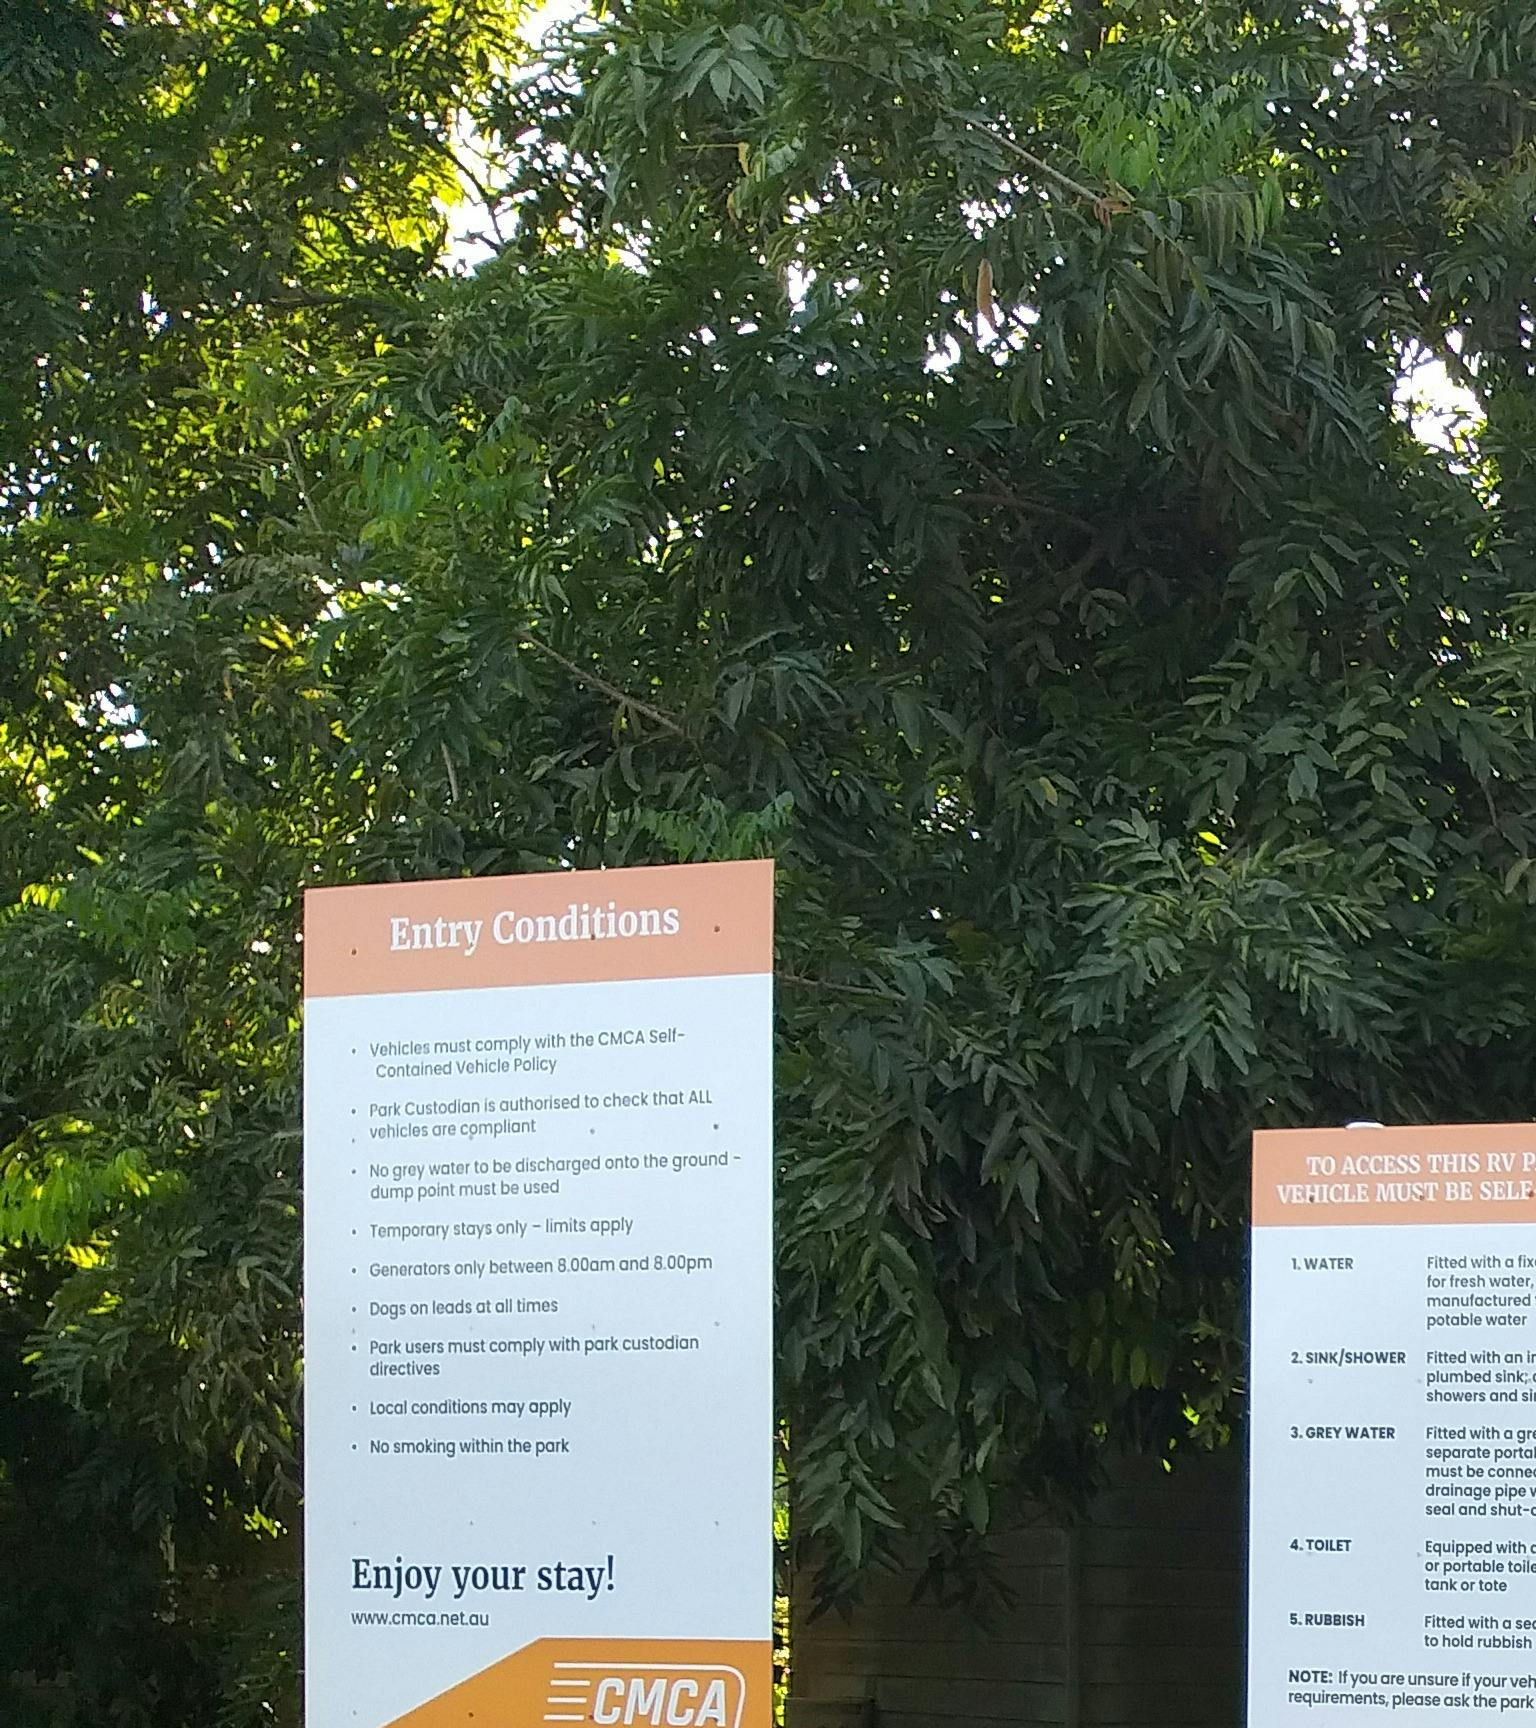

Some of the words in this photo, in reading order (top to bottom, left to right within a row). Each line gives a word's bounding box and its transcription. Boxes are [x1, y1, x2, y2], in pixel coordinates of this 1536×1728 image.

[390, 917, 483, 956] Entry
[493, 901, 679, 944] Conditions
[1306, 1156, 1335, 1175] TO
[1341, 1154, 1420, 1174] ACCESS
[1426, 1153, 1480, 1173] THIS
[1486, 1152, 1515, 1172] RV
[1276, 1183, 1369, 1203] VEHICLE
[1375, 1182, 1438, 1202] MUST
[1445, 1181, 1472, 1200] BE
[369, 1262, 450, 1277] Generators
[454, 1260, 485, 1278] only
[489, 1259, 553, 1274] between
[557, 1256, 615, 1273] 8.00am
[619, 1256, 649, 1271] and
[653, 1254, 712, 1274] 8.00pm
[1291, 1257, 1301, 1270] 1.
[1303, 1257, 1353, 1270] WATER
[370, 1301, 406, 1320] Dogs
[409, 1303, 428, 1315] on
[432, 1299, 472, 1314] leads
[475, 1299, 491, 1313] at
[495, 1298, 512, 1313] all
[516, 1297, 558, 1312] times
[1426, 1312, 1482, 1330] potable
[1485, 1313, 1527, 1325] water
[1291, 1351, 1303, 1363] 2.
[1306, 1349, 1406, 1366] SINK/SHOWER
[1290, 1426, 1303, 1438] 3.
[1305, 1426, 1342, 1438] GREY
[1344, 1426, 1395, 1439] WATER
[1289, 1538, 1303, 1550] 4.
[1305, 1538, 1352, 1551] TOILET
[351, 1556, 442, 1599] Enjoy
[451, 1566, 526, 1599] your
[537, 1555, 614, 1600] stay!
[351, 1611, 489, 1626] www.cmca.net.au
[1290, 1612, 1302, 1625] 5.
[1305, 1613, 1364, 1626] RUBBISH
[1424, 1614, 1464, 1628] Fitted
[1468, 1615, 1498, 1629] with
[1502, 1619, 1511, 1629] a
[1424, 1634, 1438, 1647] to
[1442, 1634, 1473, 1647] hold
[1477, 1634, 1532, 1649] rubbish
[593, 1678, 725, 1726] CMCA
